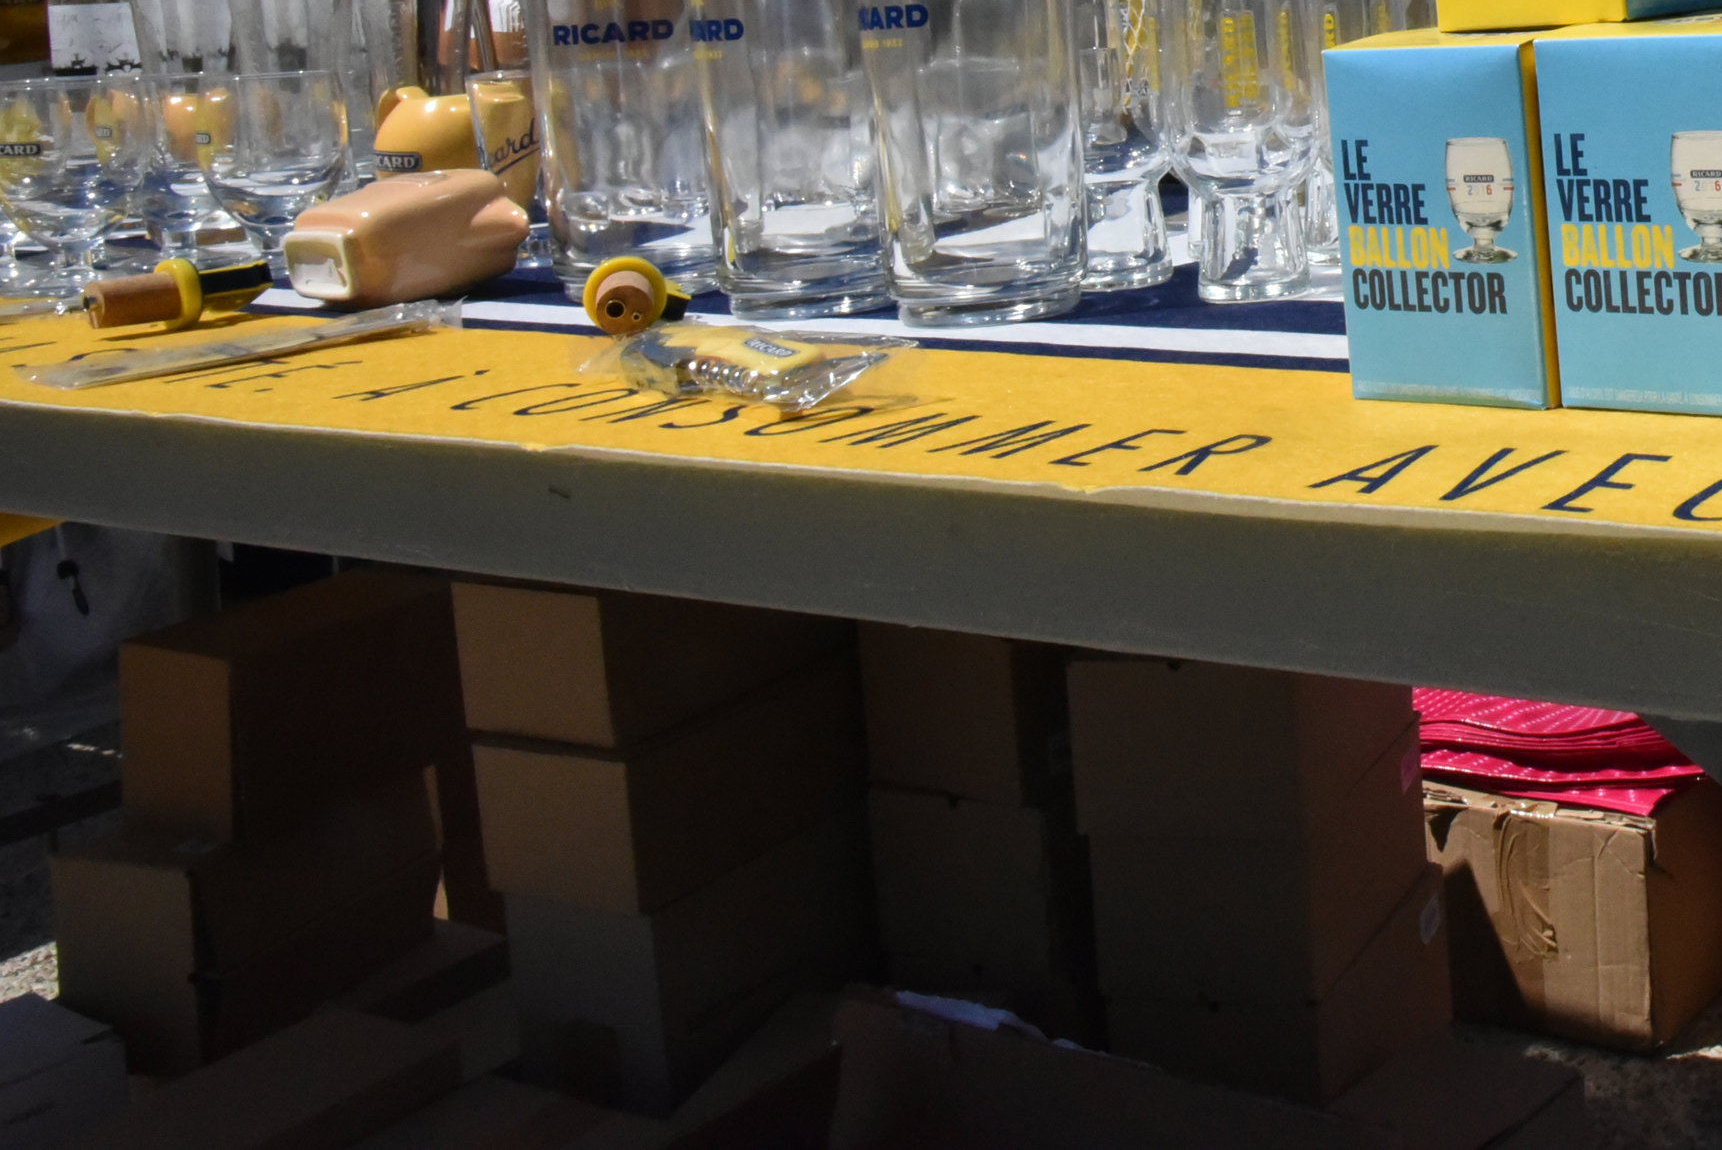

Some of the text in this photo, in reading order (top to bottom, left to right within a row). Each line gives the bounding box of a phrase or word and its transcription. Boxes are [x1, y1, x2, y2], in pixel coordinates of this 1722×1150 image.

[553, 19, 674, 46] RICARD
[377, 155, 416, 169] CARD
[1341, 140, 1371, 181] LE
[1554, 133, 1587, 176] LE
[1692, 170, 1722, 178] RICARD
[1464, 175, 1493, 183] RICARD
[1344, 183, 1428, 225] VERRE
[1556, 179, 1652, 222] VERRE
[1348, 225, 1450, 269] BALLON
[1561, 223, 1675, 269] BALLON
[1352, 268, 1508, 315] COLLECTOR
[746, 338, 793, 356] RICARD
[450, 383, 1272, 475] CONSOMMER
